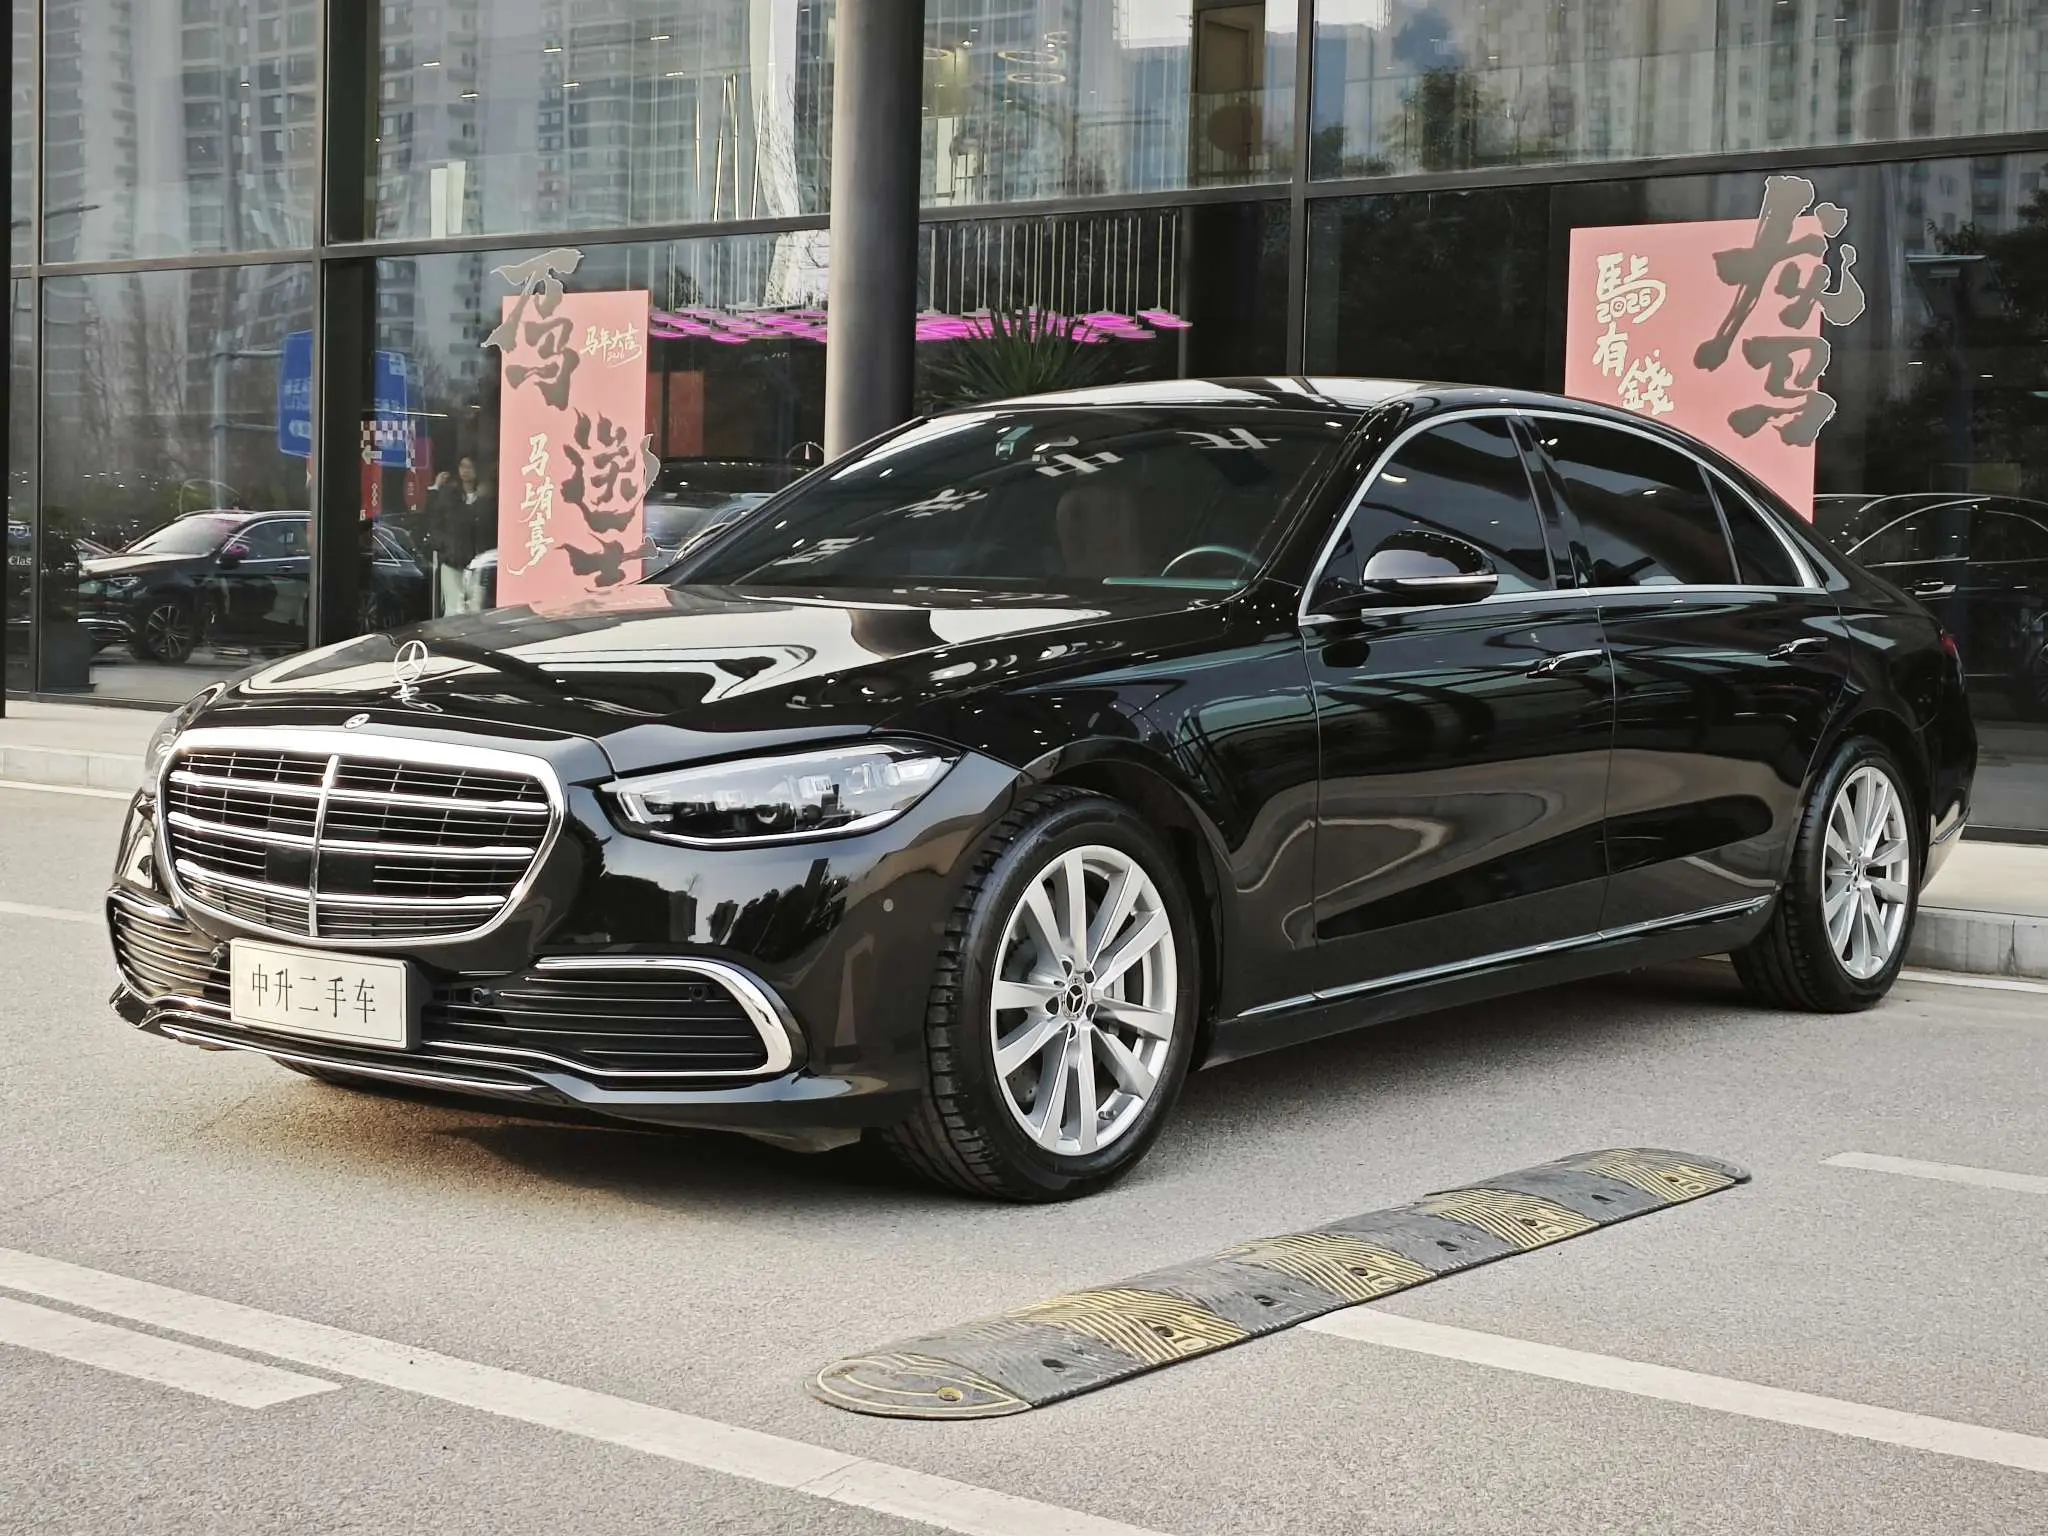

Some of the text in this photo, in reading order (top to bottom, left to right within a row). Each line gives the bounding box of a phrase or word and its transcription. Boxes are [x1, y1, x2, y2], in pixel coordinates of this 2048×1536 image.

[1596, 288, 1653, 324] 2026
[252, 963, 376, 1024] 中升二手车
